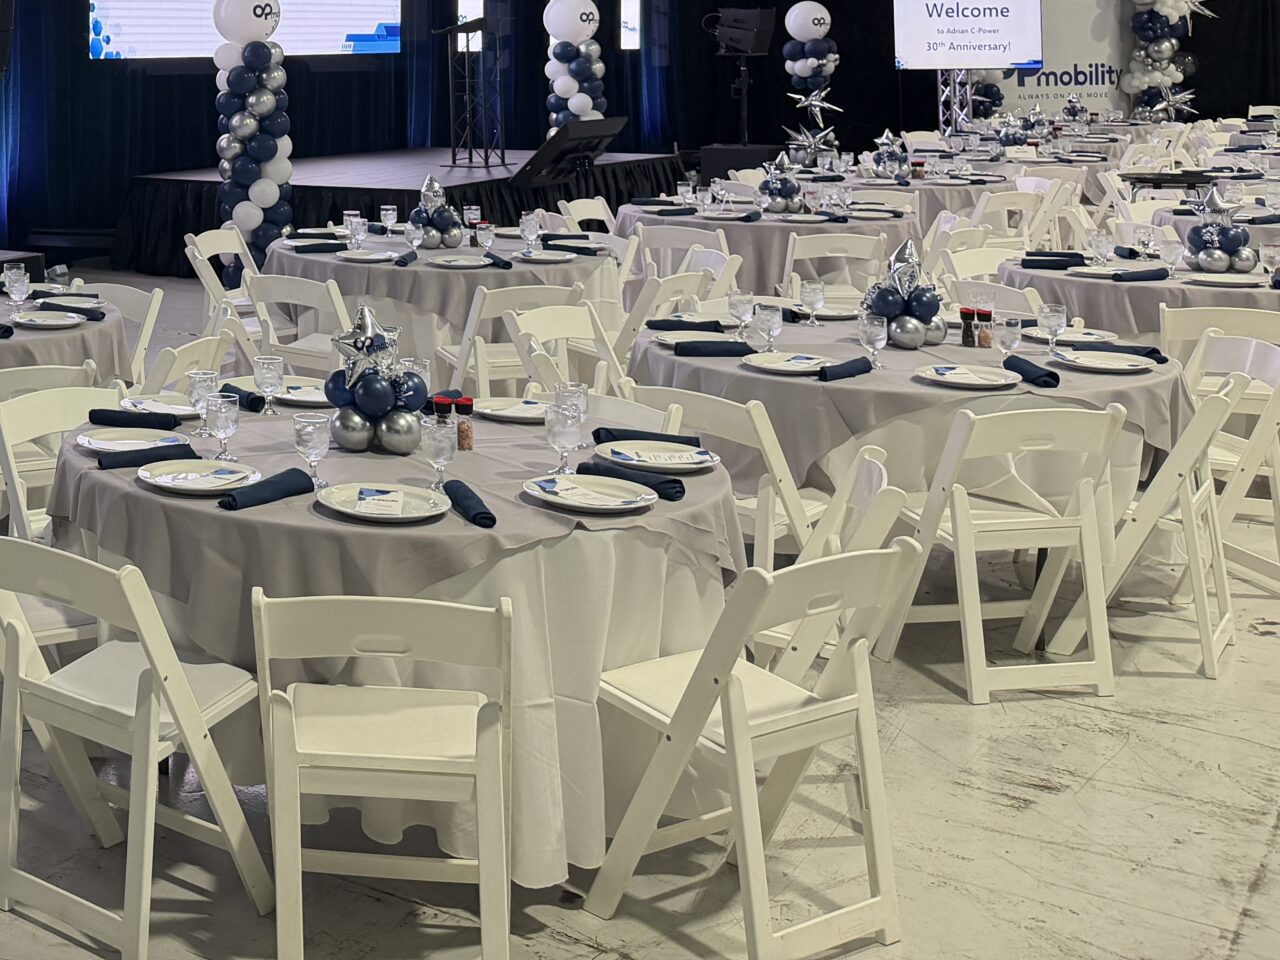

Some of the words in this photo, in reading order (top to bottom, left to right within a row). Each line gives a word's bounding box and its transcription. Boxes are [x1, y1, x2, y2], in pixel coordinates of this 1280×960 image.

[925, 2, 1010, 18] Welcome
[926, 41, 946, 51] 30th
[949, 41, 1011, 53] Anniversary!
[1002, 63, 1123, 90] Pmobility
